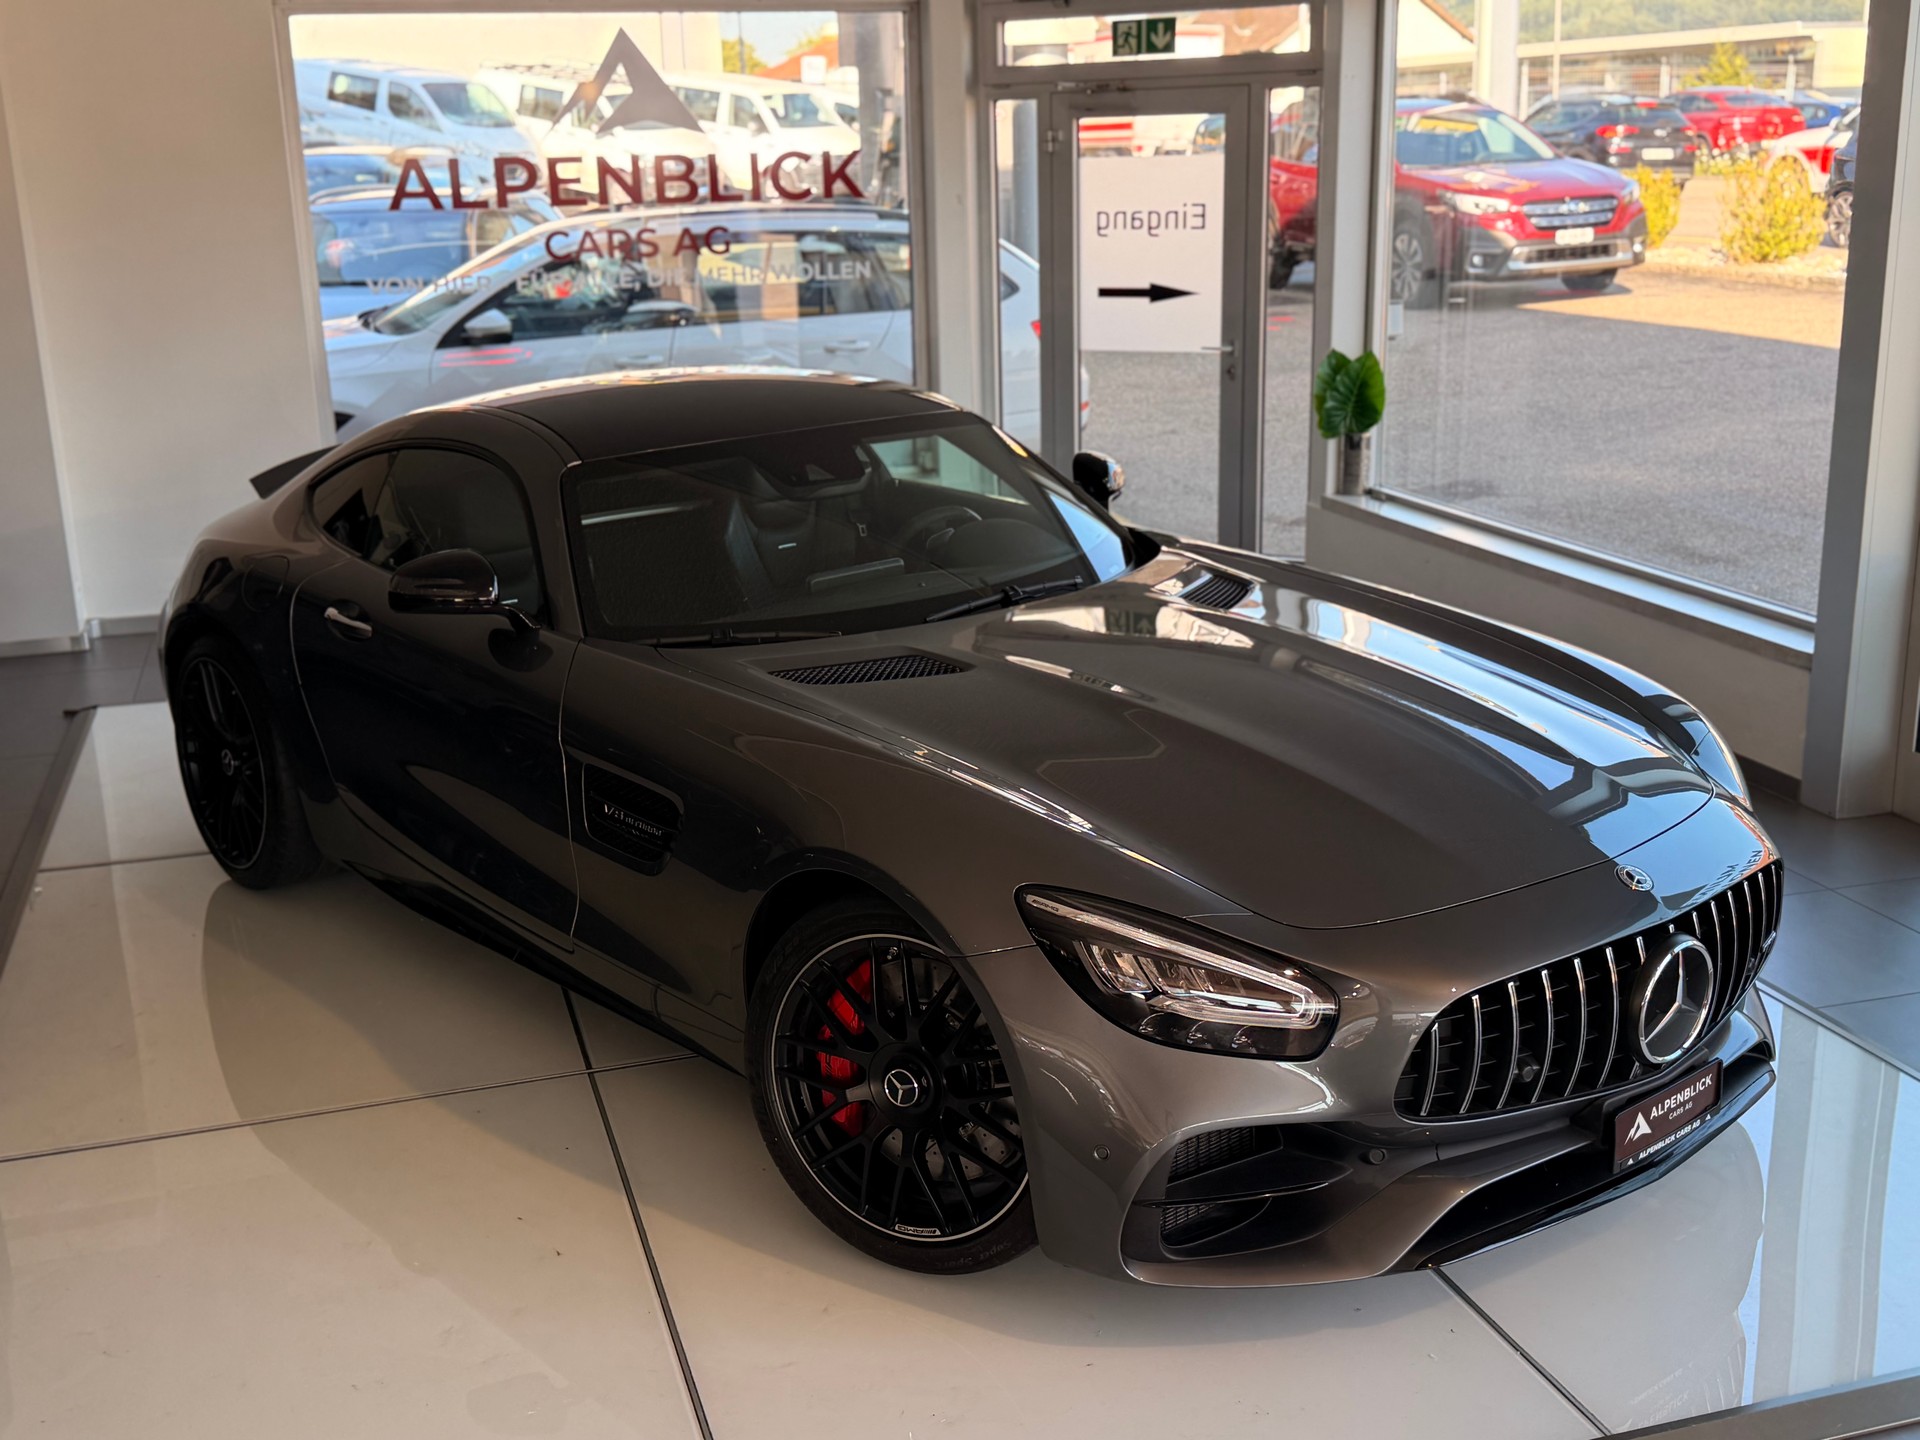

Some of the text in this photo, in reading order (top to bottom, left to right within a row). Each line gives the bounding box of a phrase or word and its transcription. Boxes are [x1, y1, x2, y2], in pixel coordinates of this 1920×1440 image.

[388, 149, 866, 211] ALPENBLICK
[544, 226, 731, 262] CARS AG
[365, 276, 424, 295] VON
[696, 266, 763, 285] MEHR
[769, 261, 872, 282] WOLLEN
[1650, 1073, 1713, 1120] ALPENBLICK
[1668, 1101, 1693, 1120] CARS AG
[1639, 1119, 1701, 1160] ALPENBLICK CARS AG
